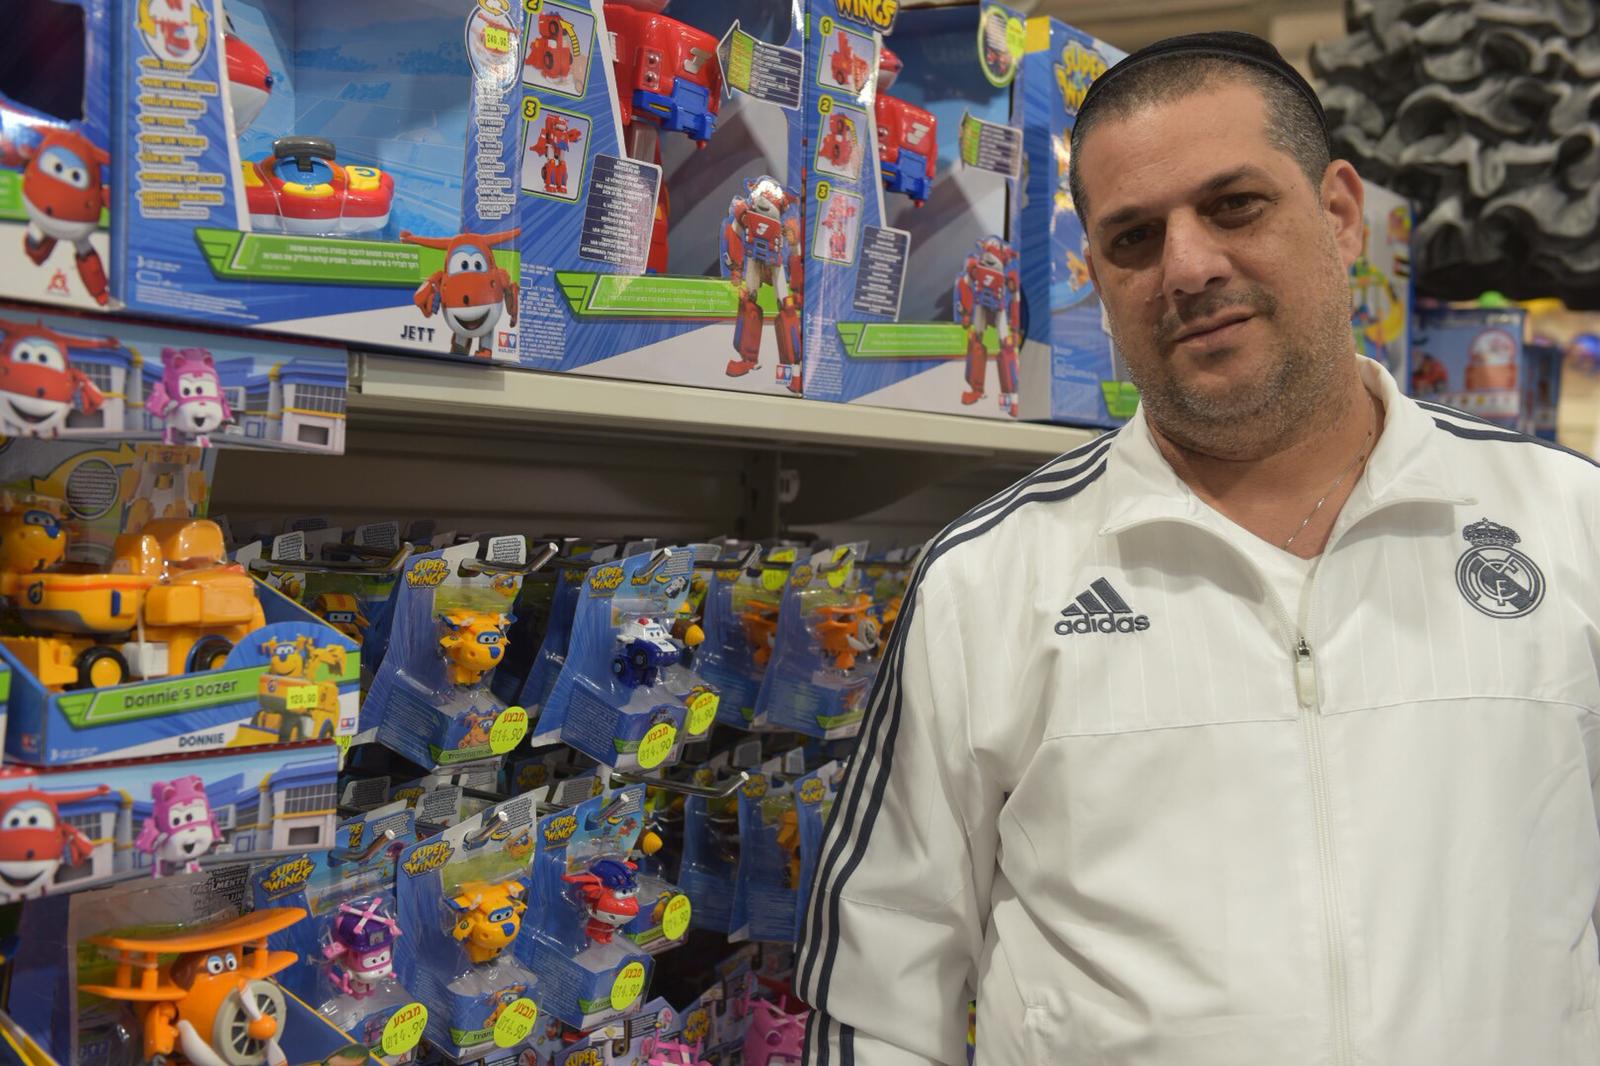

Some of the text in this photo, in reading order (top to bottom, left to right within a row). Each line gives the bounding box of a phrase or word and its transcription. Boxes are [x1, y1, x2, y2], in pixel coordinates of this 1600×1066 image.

[400, 325, 435, 342] JETT
[406, 570, 450, 586] WINGS
[415, 559, 447, 576] SUPER
[1054, 612, 1151, 635] adidas
[124, 680, 239, 708] Donnie's Dozer
[503, 711, 526, 724] מבצע
[178, 732, 225, 748] DONNIE
[403, 851, 453, 875] WINGS
[410, 842, 449, 864] SUPER
[261, 865, 315, 892] WINGS
[271, 857, 310, 882] SUPER
[392, 1005, 422, 1029] מבצע
